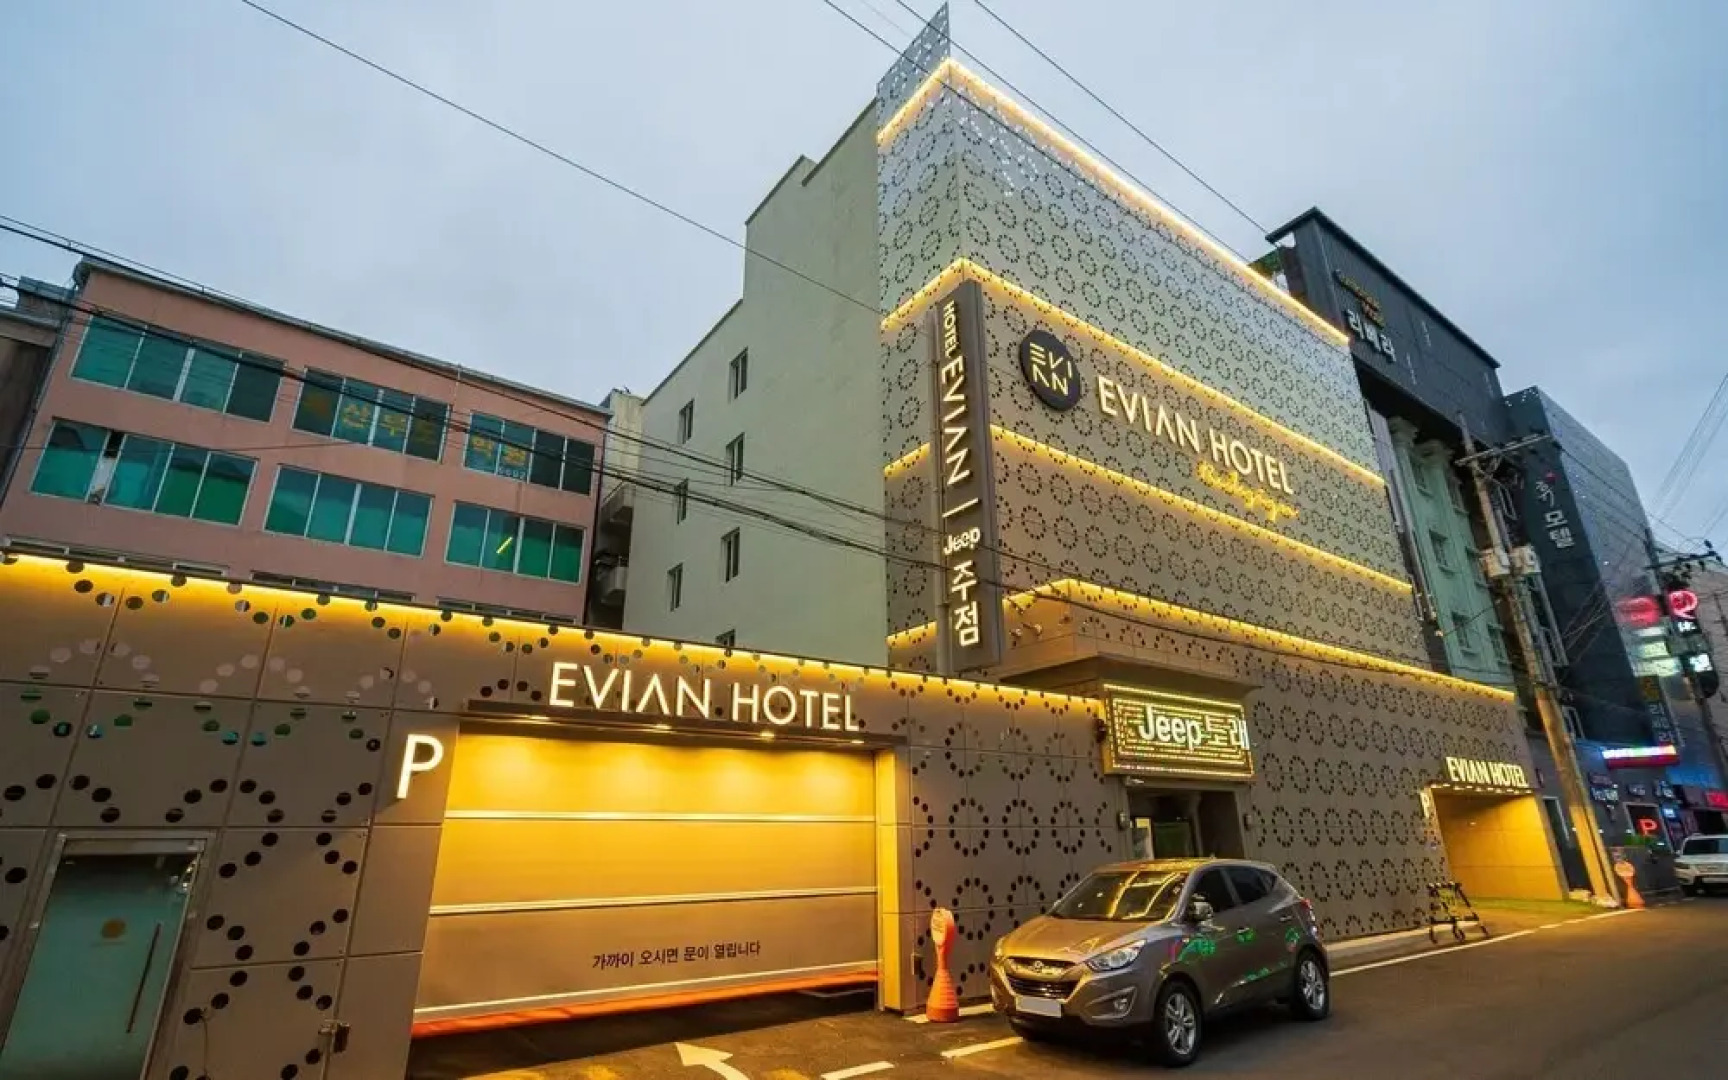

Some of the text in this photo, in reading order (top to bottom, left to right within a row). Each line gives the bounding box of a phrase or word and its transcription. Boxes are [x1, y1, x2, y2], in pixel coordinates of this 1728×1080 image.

[942, 300, 971, 486] HOTEL EVIAN
[1097, 375, 1201, 454] EVIAN
[1208, 428, 1294, 495] HOTEL
[943, 526, 981, 555] Jeep
[951, 559, 979, 647] 주점
[548, 661, 860, 733] EVIAN HOTEL
[1139, 703, 1200, 751] Jeep
[396, 733, 444, 799] P
[1446, 756, 1530, 788] EVIAN HOTEL
[1639, 818, 1658, 837] P
[592, 940, 761, 970] 가까이 오시면 문이 열립니다
